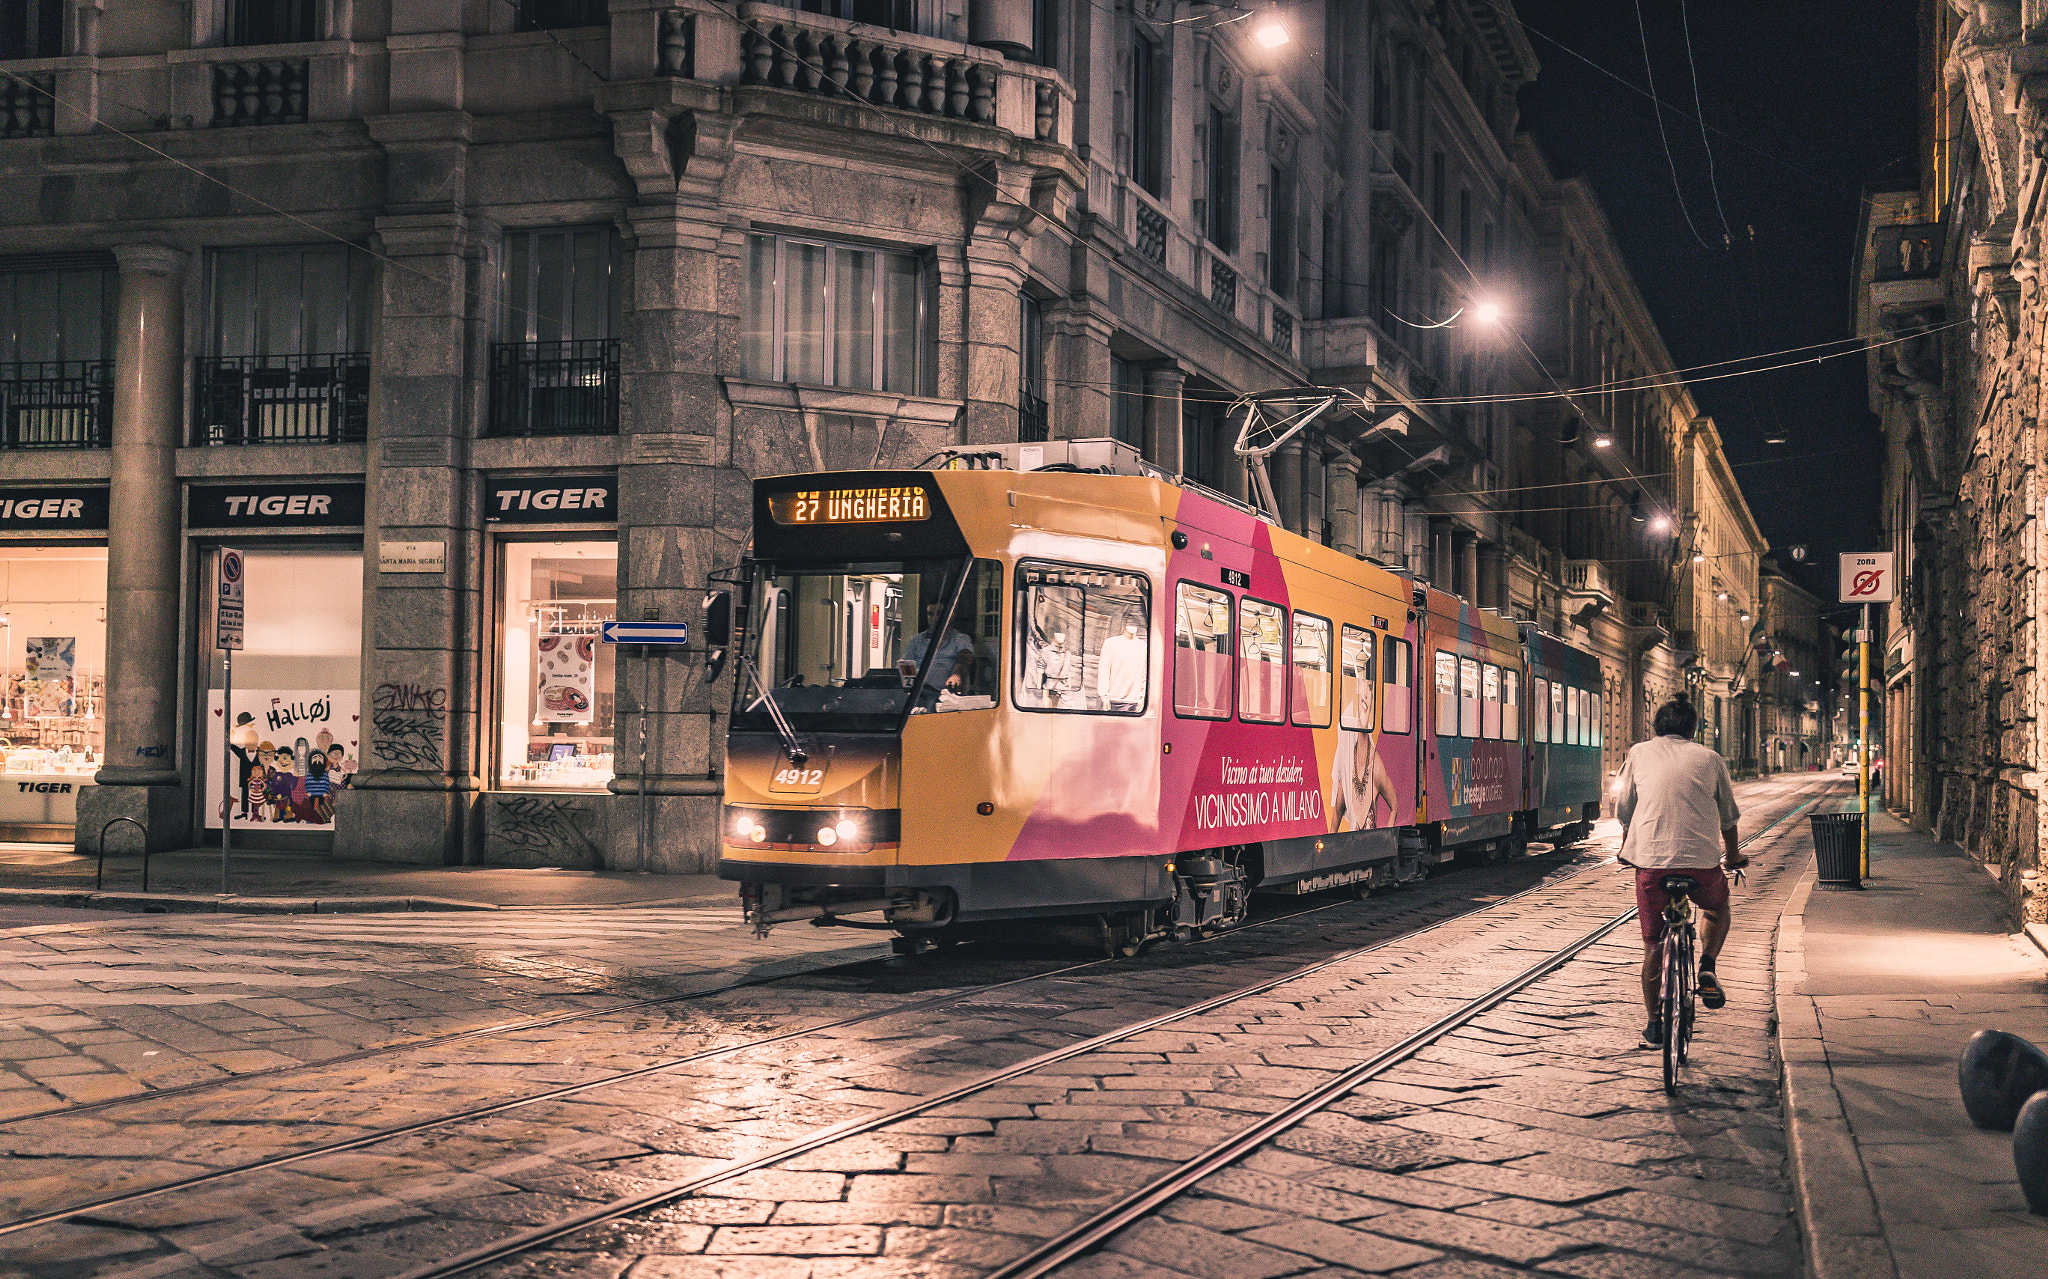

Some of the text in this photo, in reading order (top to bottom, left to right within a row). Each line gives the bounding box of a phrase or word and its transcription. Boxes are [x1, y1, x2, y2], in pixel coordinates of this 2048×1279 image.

[225, 495, 332, 516] TIGER
[496, 488, 608, 511] TIGER
[796, 496, 924, 521] 27 UNGHERIA
[1856, 558, 1876, 566] zona
[1228, 569, 1242, 587] 4912
[266, 694, 331, 732] Halløj
[775, 769, 823, 785] 4912
[1221, 755, 1304, 786] Vicino ai tuoi desideri,
[18, 782, 72, 794] TIGER
[1194, 789, 1321, 830] VICINISSIMO A MILANO
